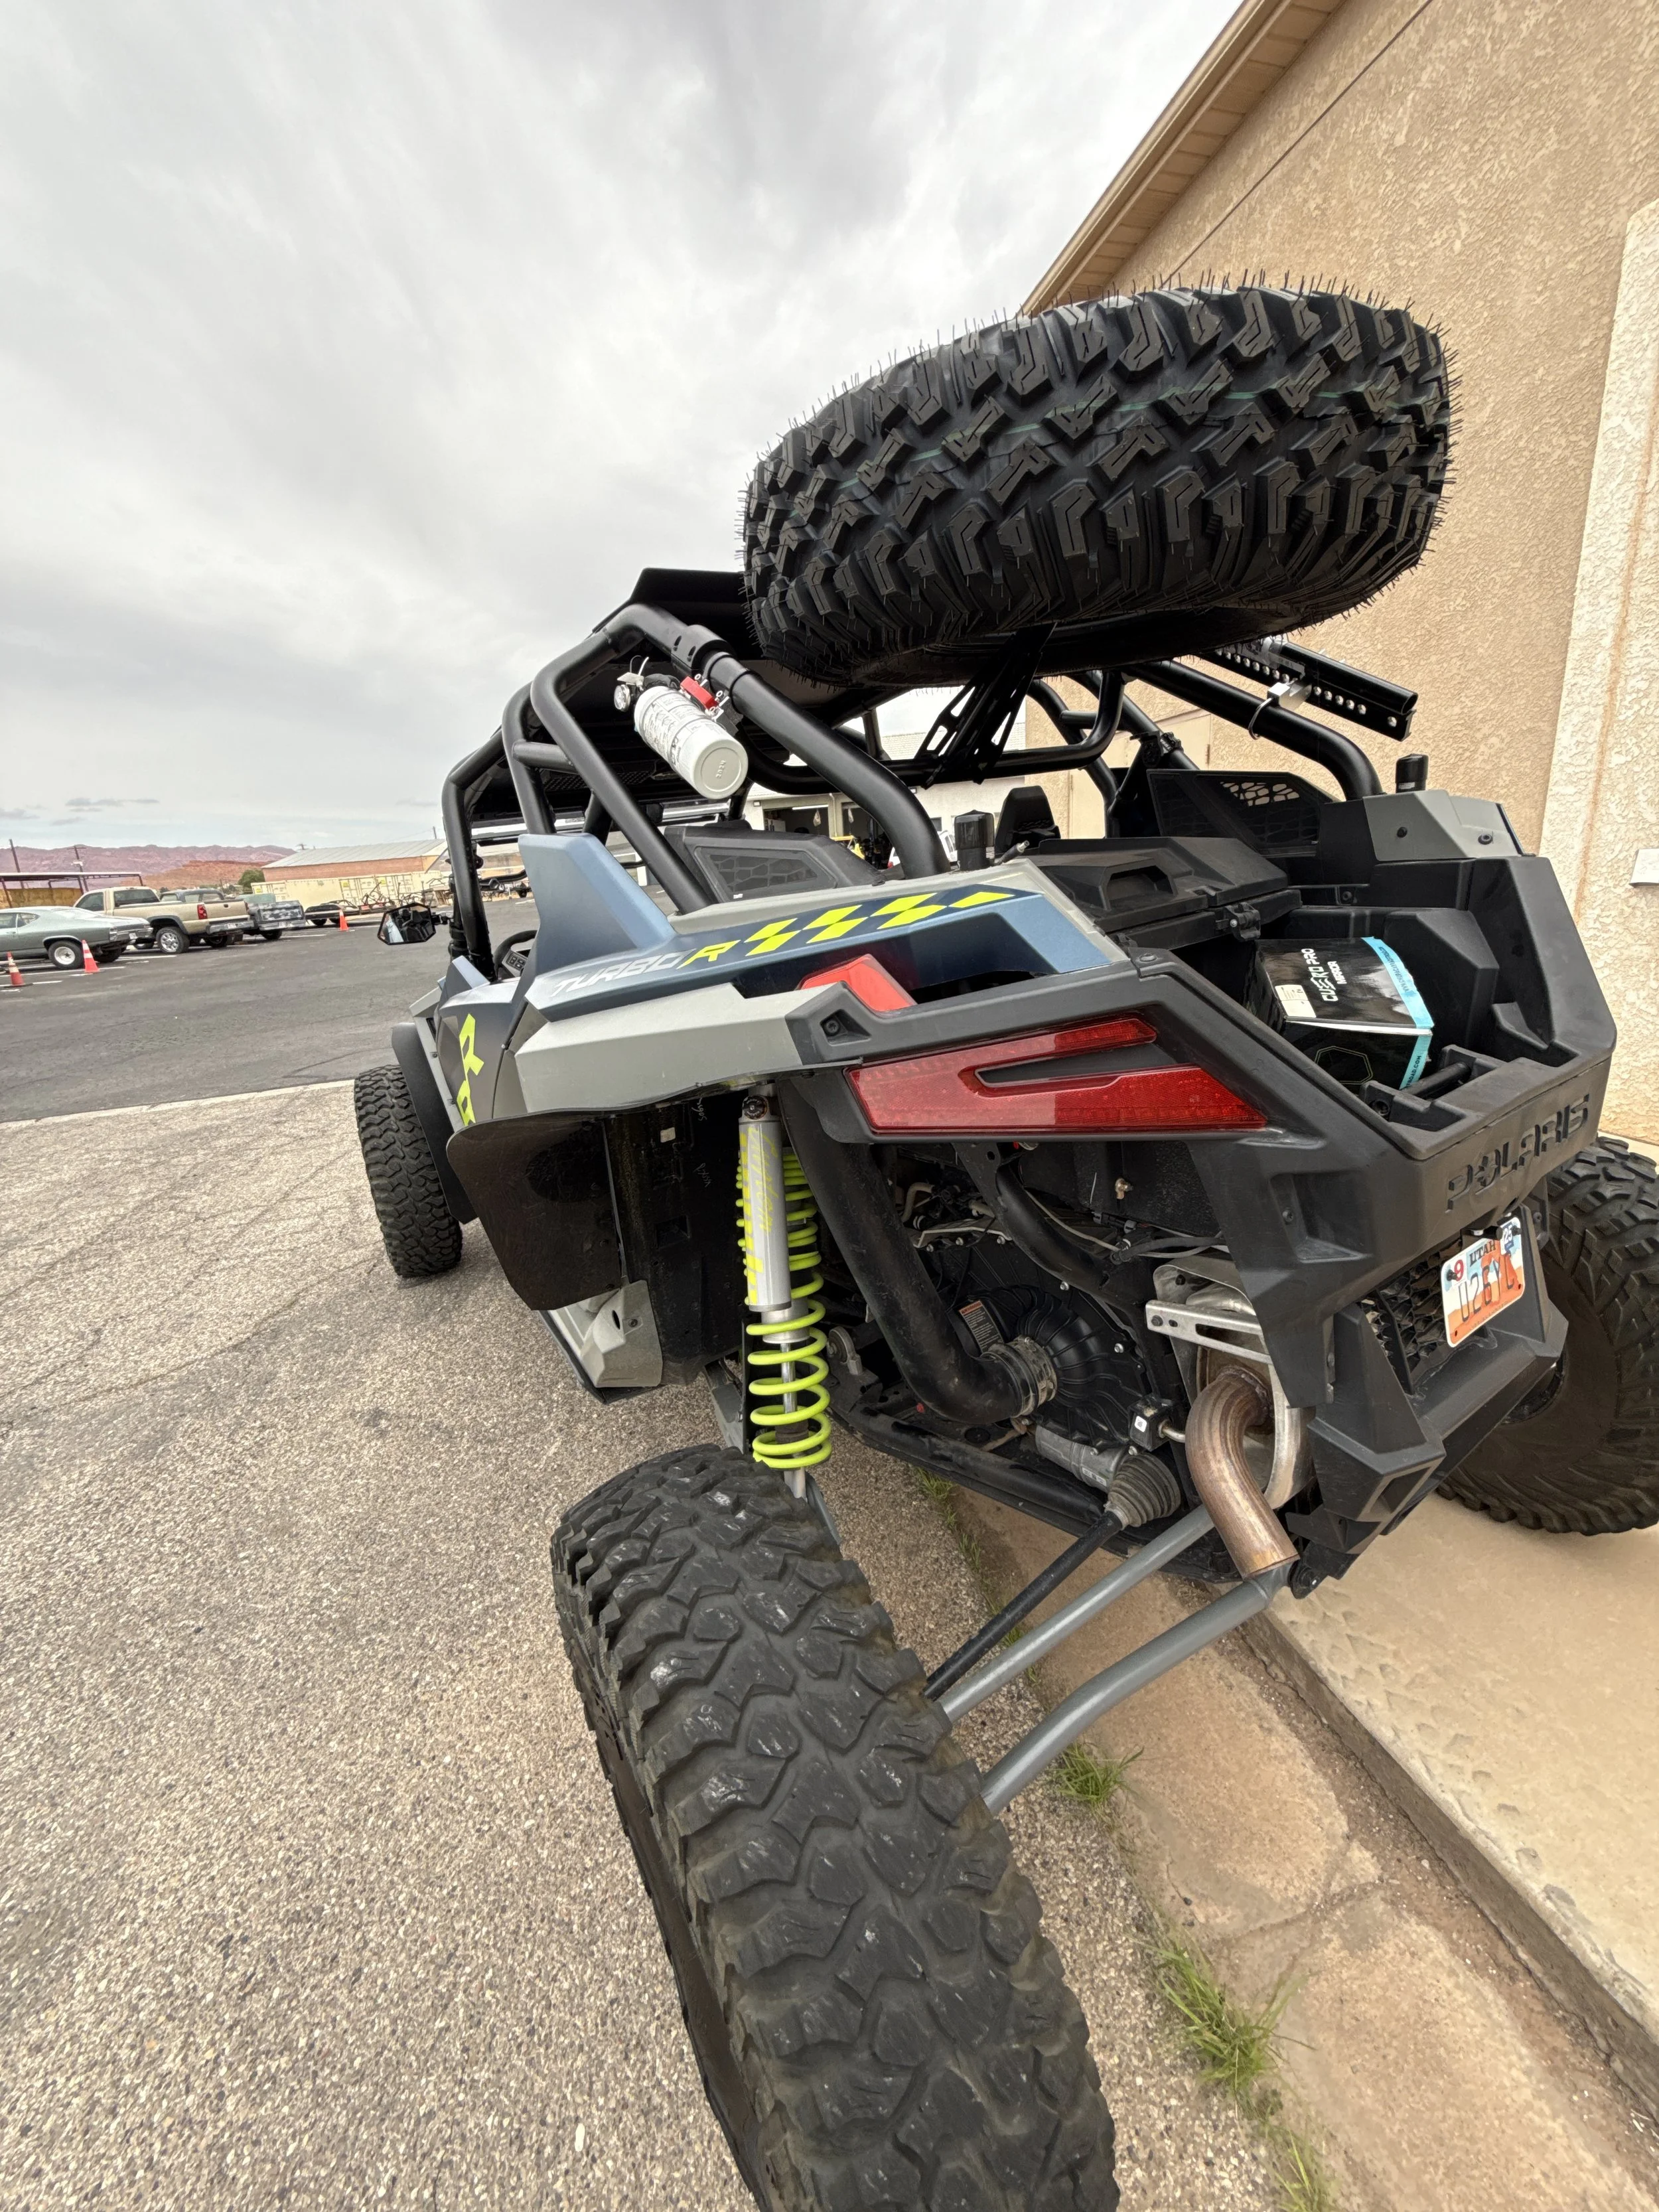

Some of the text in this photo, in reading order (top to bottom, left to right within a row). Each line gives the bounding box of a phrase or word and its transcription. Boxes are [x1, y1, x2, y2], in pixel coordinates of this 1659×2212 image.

[550, 939, 741, 997] TURBO R
[1301, 948, 1320, 964] PRO
[1327, 960, 1347, 984] MIRROR
[1444, 1092, 1590, 1213] POLARIS
[1504, 1224, 1512, 1244] 25
[1469, 1240, 1496, 1267] UTAH
[1454, 1260, 1464, 1281] 9
